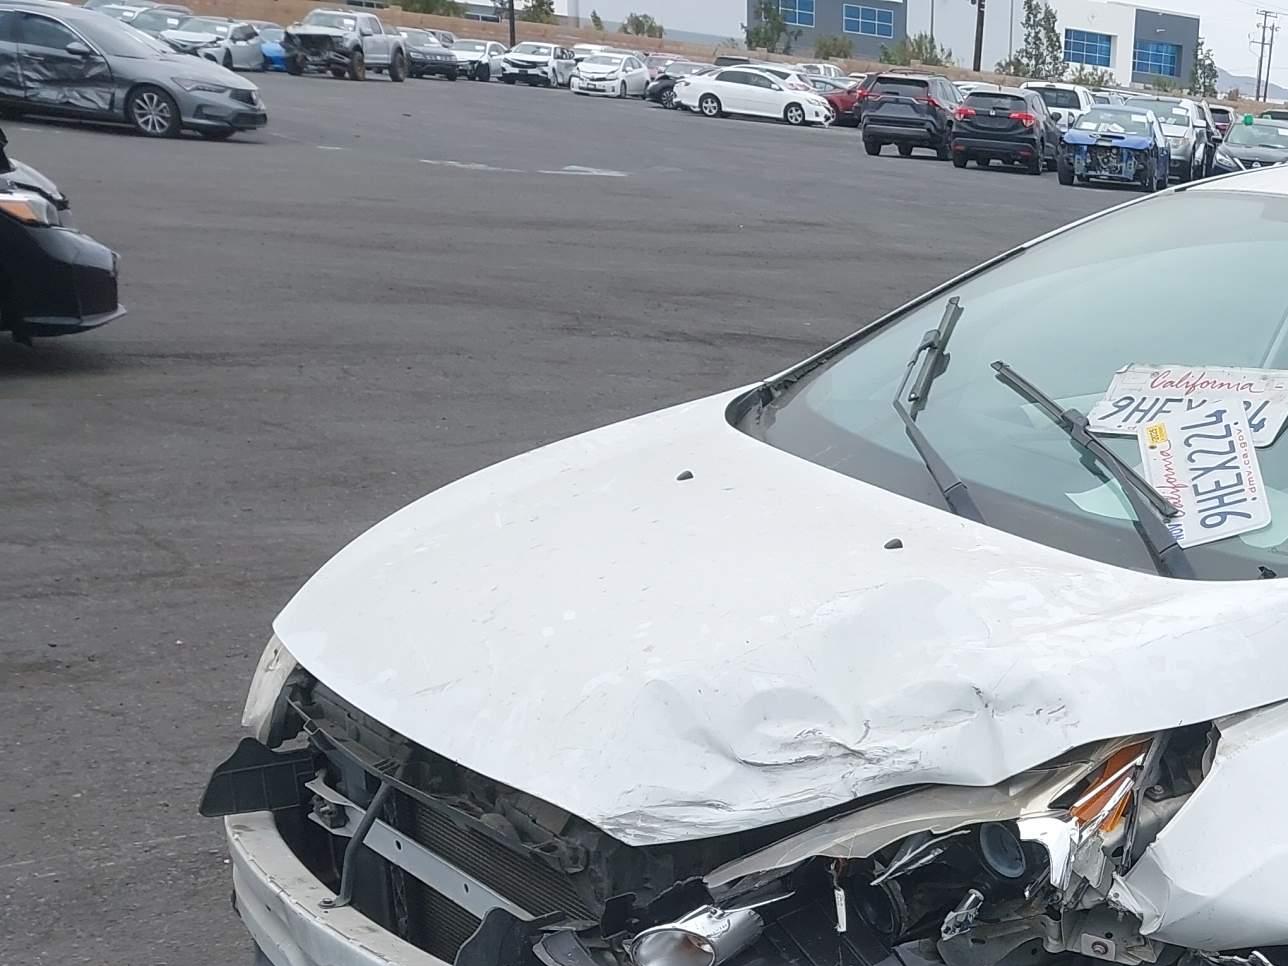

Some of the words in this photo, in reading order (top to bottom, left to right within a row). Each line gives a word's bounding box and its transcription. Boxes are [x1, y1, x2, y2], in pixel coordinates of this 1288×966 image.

[1150, 370, 1265, 396] California
[1180, 409, 1253, 529] 9HEX224
[1236, 428, 1257, 494] dmv.ca.gov
